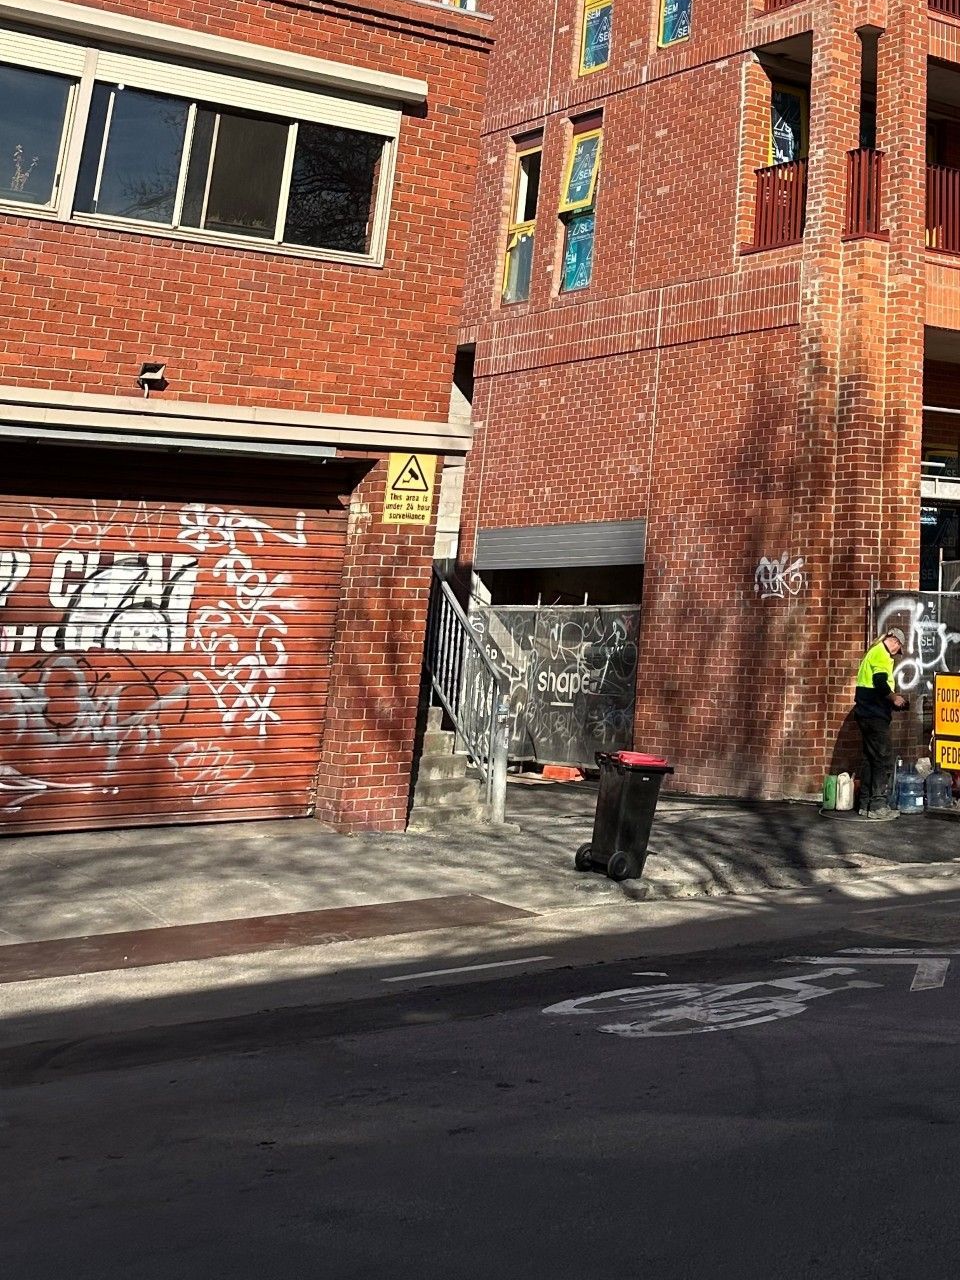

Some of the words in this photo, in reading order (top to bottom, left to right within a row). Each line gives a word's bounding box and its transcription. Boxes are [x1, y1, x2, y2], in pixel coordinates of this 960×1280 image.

[599, 31, 611, 43] SE
[677, 25, 690, 38] SE
[390, 493, 402, 501] This
[406, 494, 419, 502] area
[422, 494, 429, 502] is
[385, 503, 403, 511] under
[417, 504, 430, 512] hour
[537, 665, 591, 699] shape
